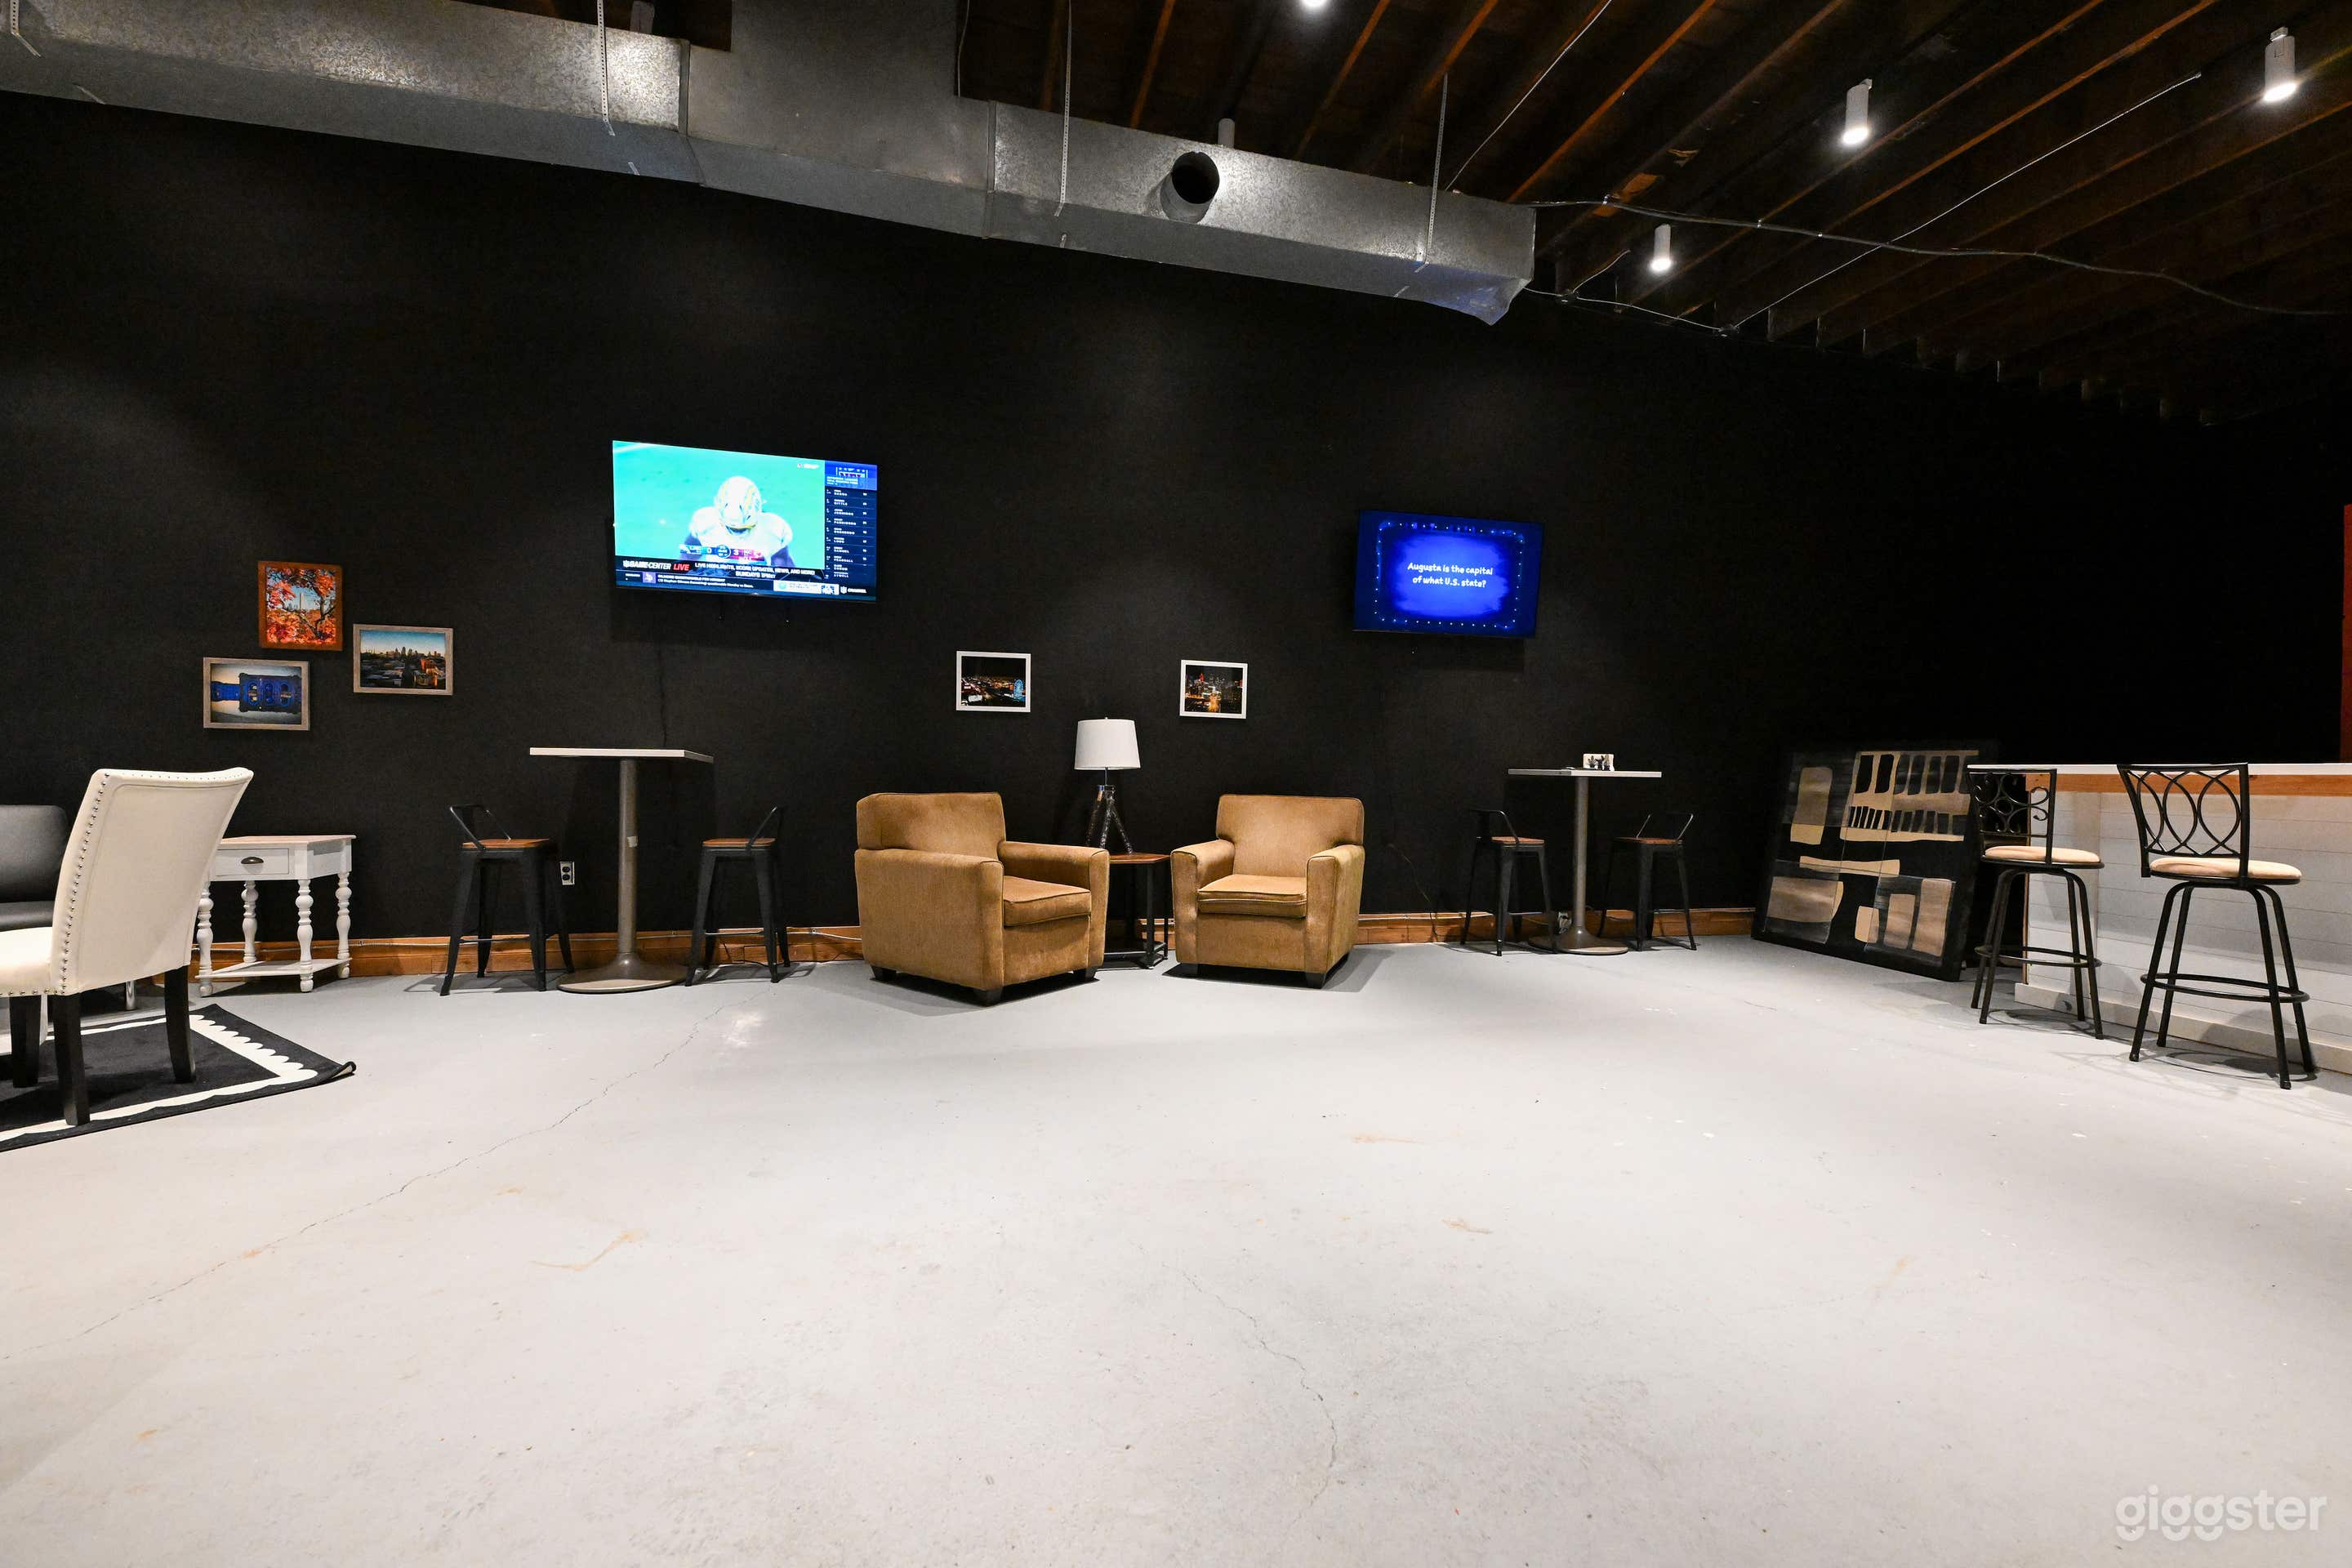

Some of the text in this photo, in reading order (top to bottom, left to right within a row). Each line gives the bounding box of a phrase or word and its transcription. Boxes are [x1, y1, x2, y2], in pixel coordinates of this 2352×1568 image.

[673, 563, 690, 571] LIVE
[1407, 562, 1493, 576] Augusta is the capital
[1412, 576, 1486, 588] of what U.S. state?
